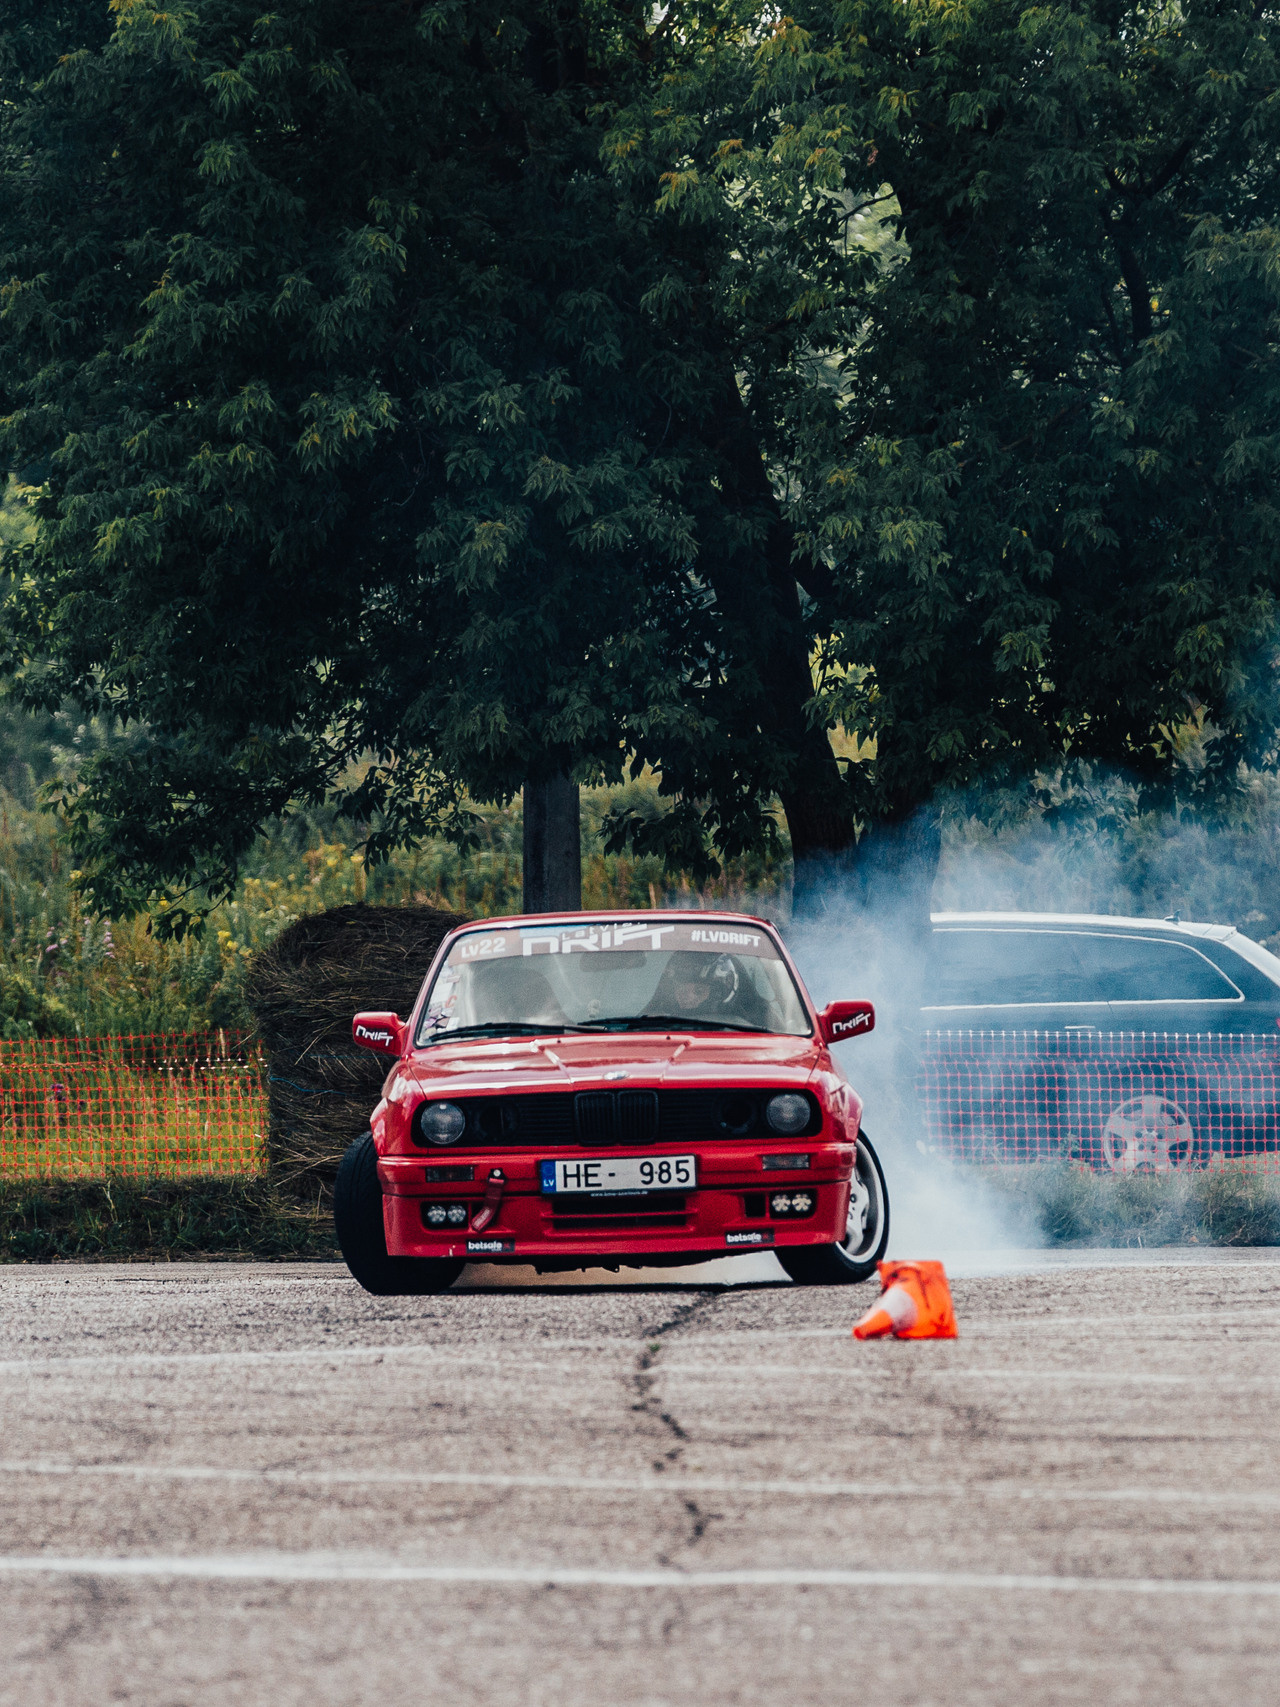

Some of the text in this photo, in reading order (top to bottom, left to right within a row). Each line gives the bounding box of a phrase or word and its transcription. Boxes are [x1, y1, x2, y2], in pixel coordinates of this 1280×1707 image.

[461, 936, 506, 958] LV22
[522, 923, 675, 956] DRIFT
[691, 930, 761, 947] #LVDRIFT
[831, 1012, 871, 1034] DRIFT
[355, 1025, 394, 1047] DRIFT
[543, 1179, 554, 1187] LV
[639, 1160, 690, 1185] 985
